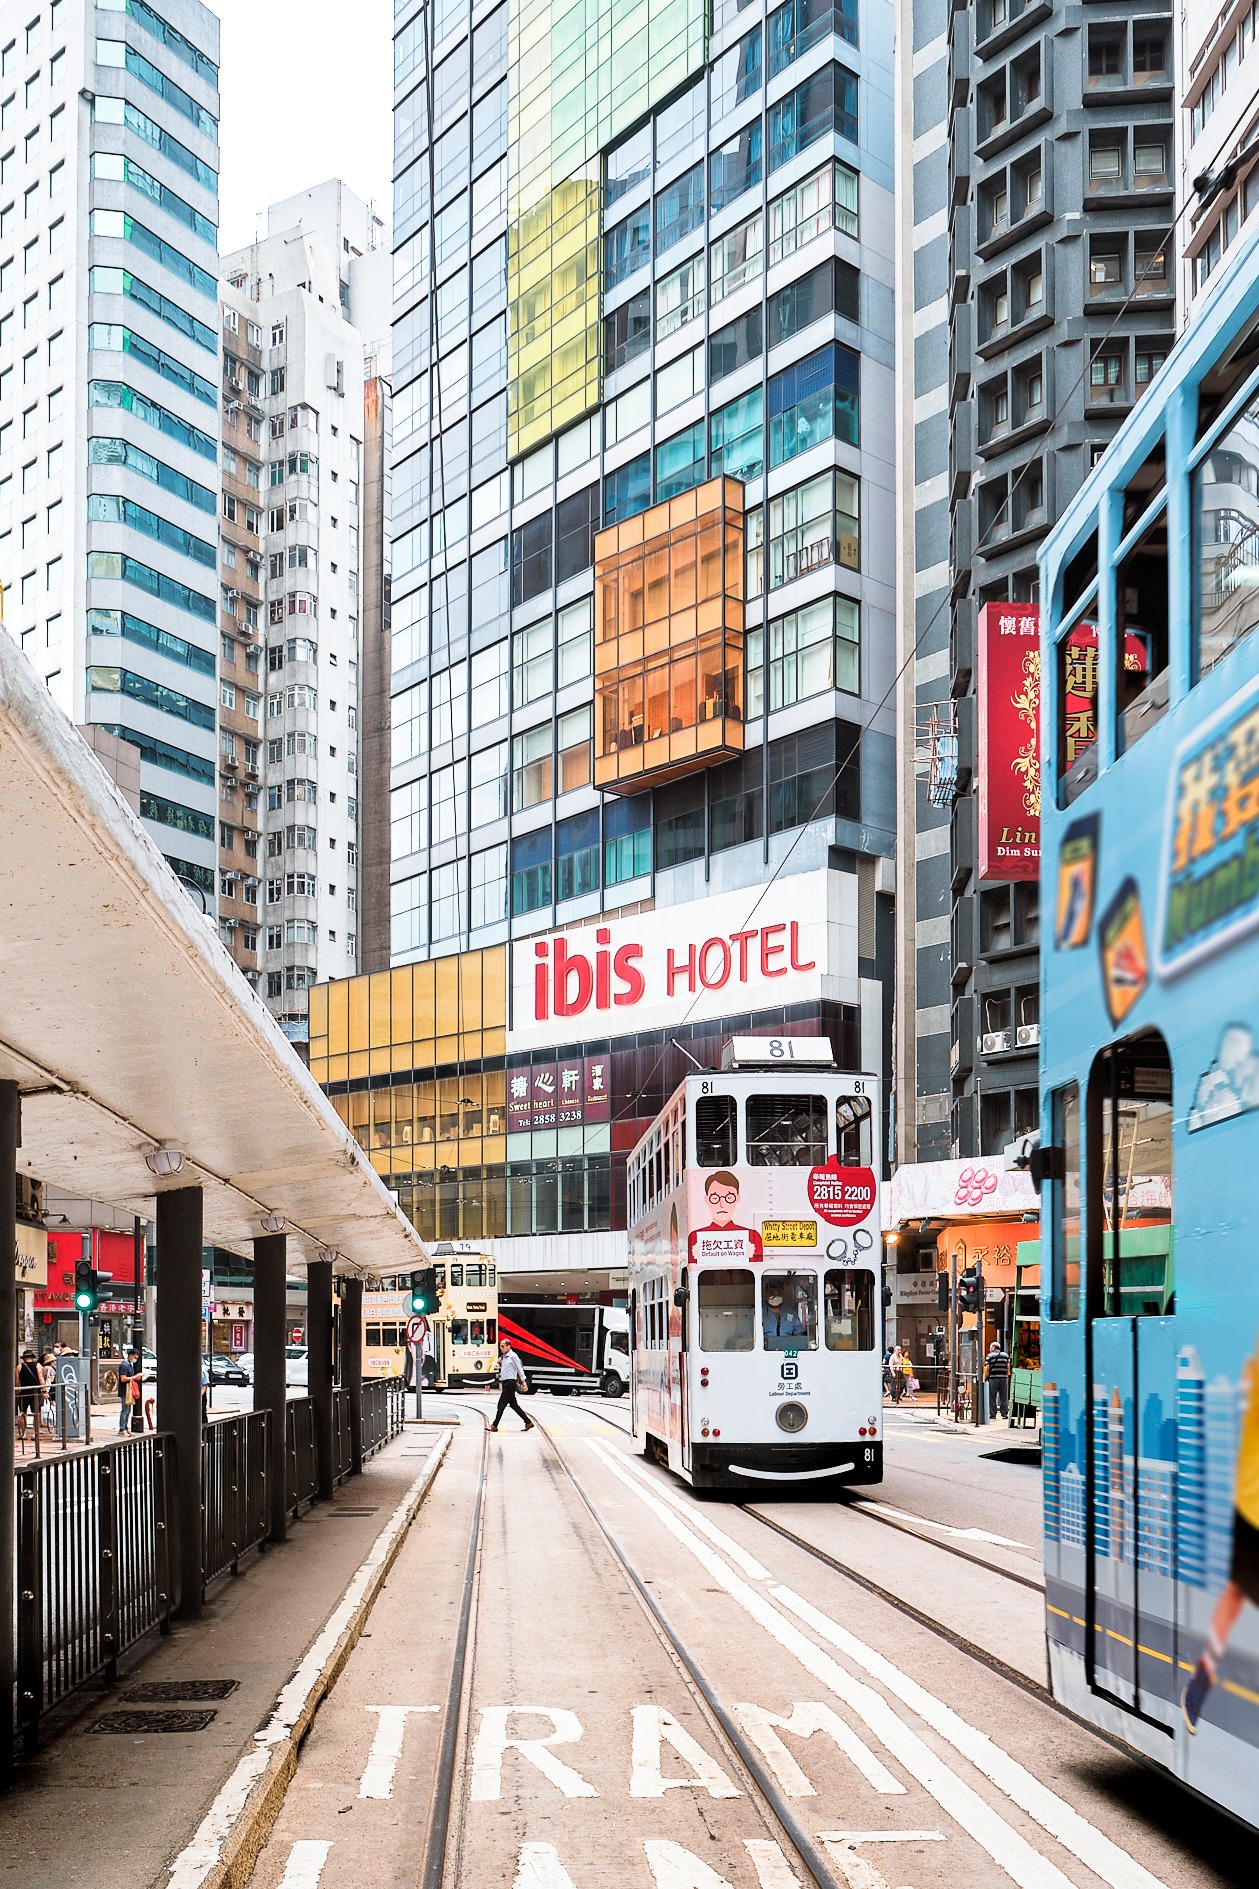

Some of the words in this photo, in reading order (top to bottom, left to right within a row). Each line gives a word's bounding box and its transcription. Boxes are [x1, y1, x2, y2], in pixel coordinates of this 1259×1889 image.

[998, 616, 1041, 636] 懷舊
[999, 826, 1037, 844] Lin
[997, 847, 1021, 857] Dim
[534, 927, 646, 1021] ibis
[666, 920, 816, 997] HOTEL
[768, 1039, 795, 1060] 81
[700, 1081, 714, 1094] 81
[853, 1080, 866, 1094] 81
[509, 1102, 531, 1113] Sweet
[533, 1099, 555, 1109] heart
[562, 1098, 580, 1106] Chinese
[533, 1113, 557, 1125] 2858
[559, 1110, 583, 1122] 3238
[813, 1186, 842, 1200] 2815
[844, 1186, 871, 1201] 2200
[764, 1222, 781, 1232] Whitty
[782, 1222, 799, 1231] Street
[800, 1222, 815, 1231] Depot
[460, 1243, 472, 1251] 79
[702, 1239, 744, 1251] 拖欠工資
[972, 1245, 1017, 1268] 永裕
[784, 1349, 798, 1358] 042
[864, 1447, 875, 1462] 81
[356, 1701, 909, 1800] TRAM
